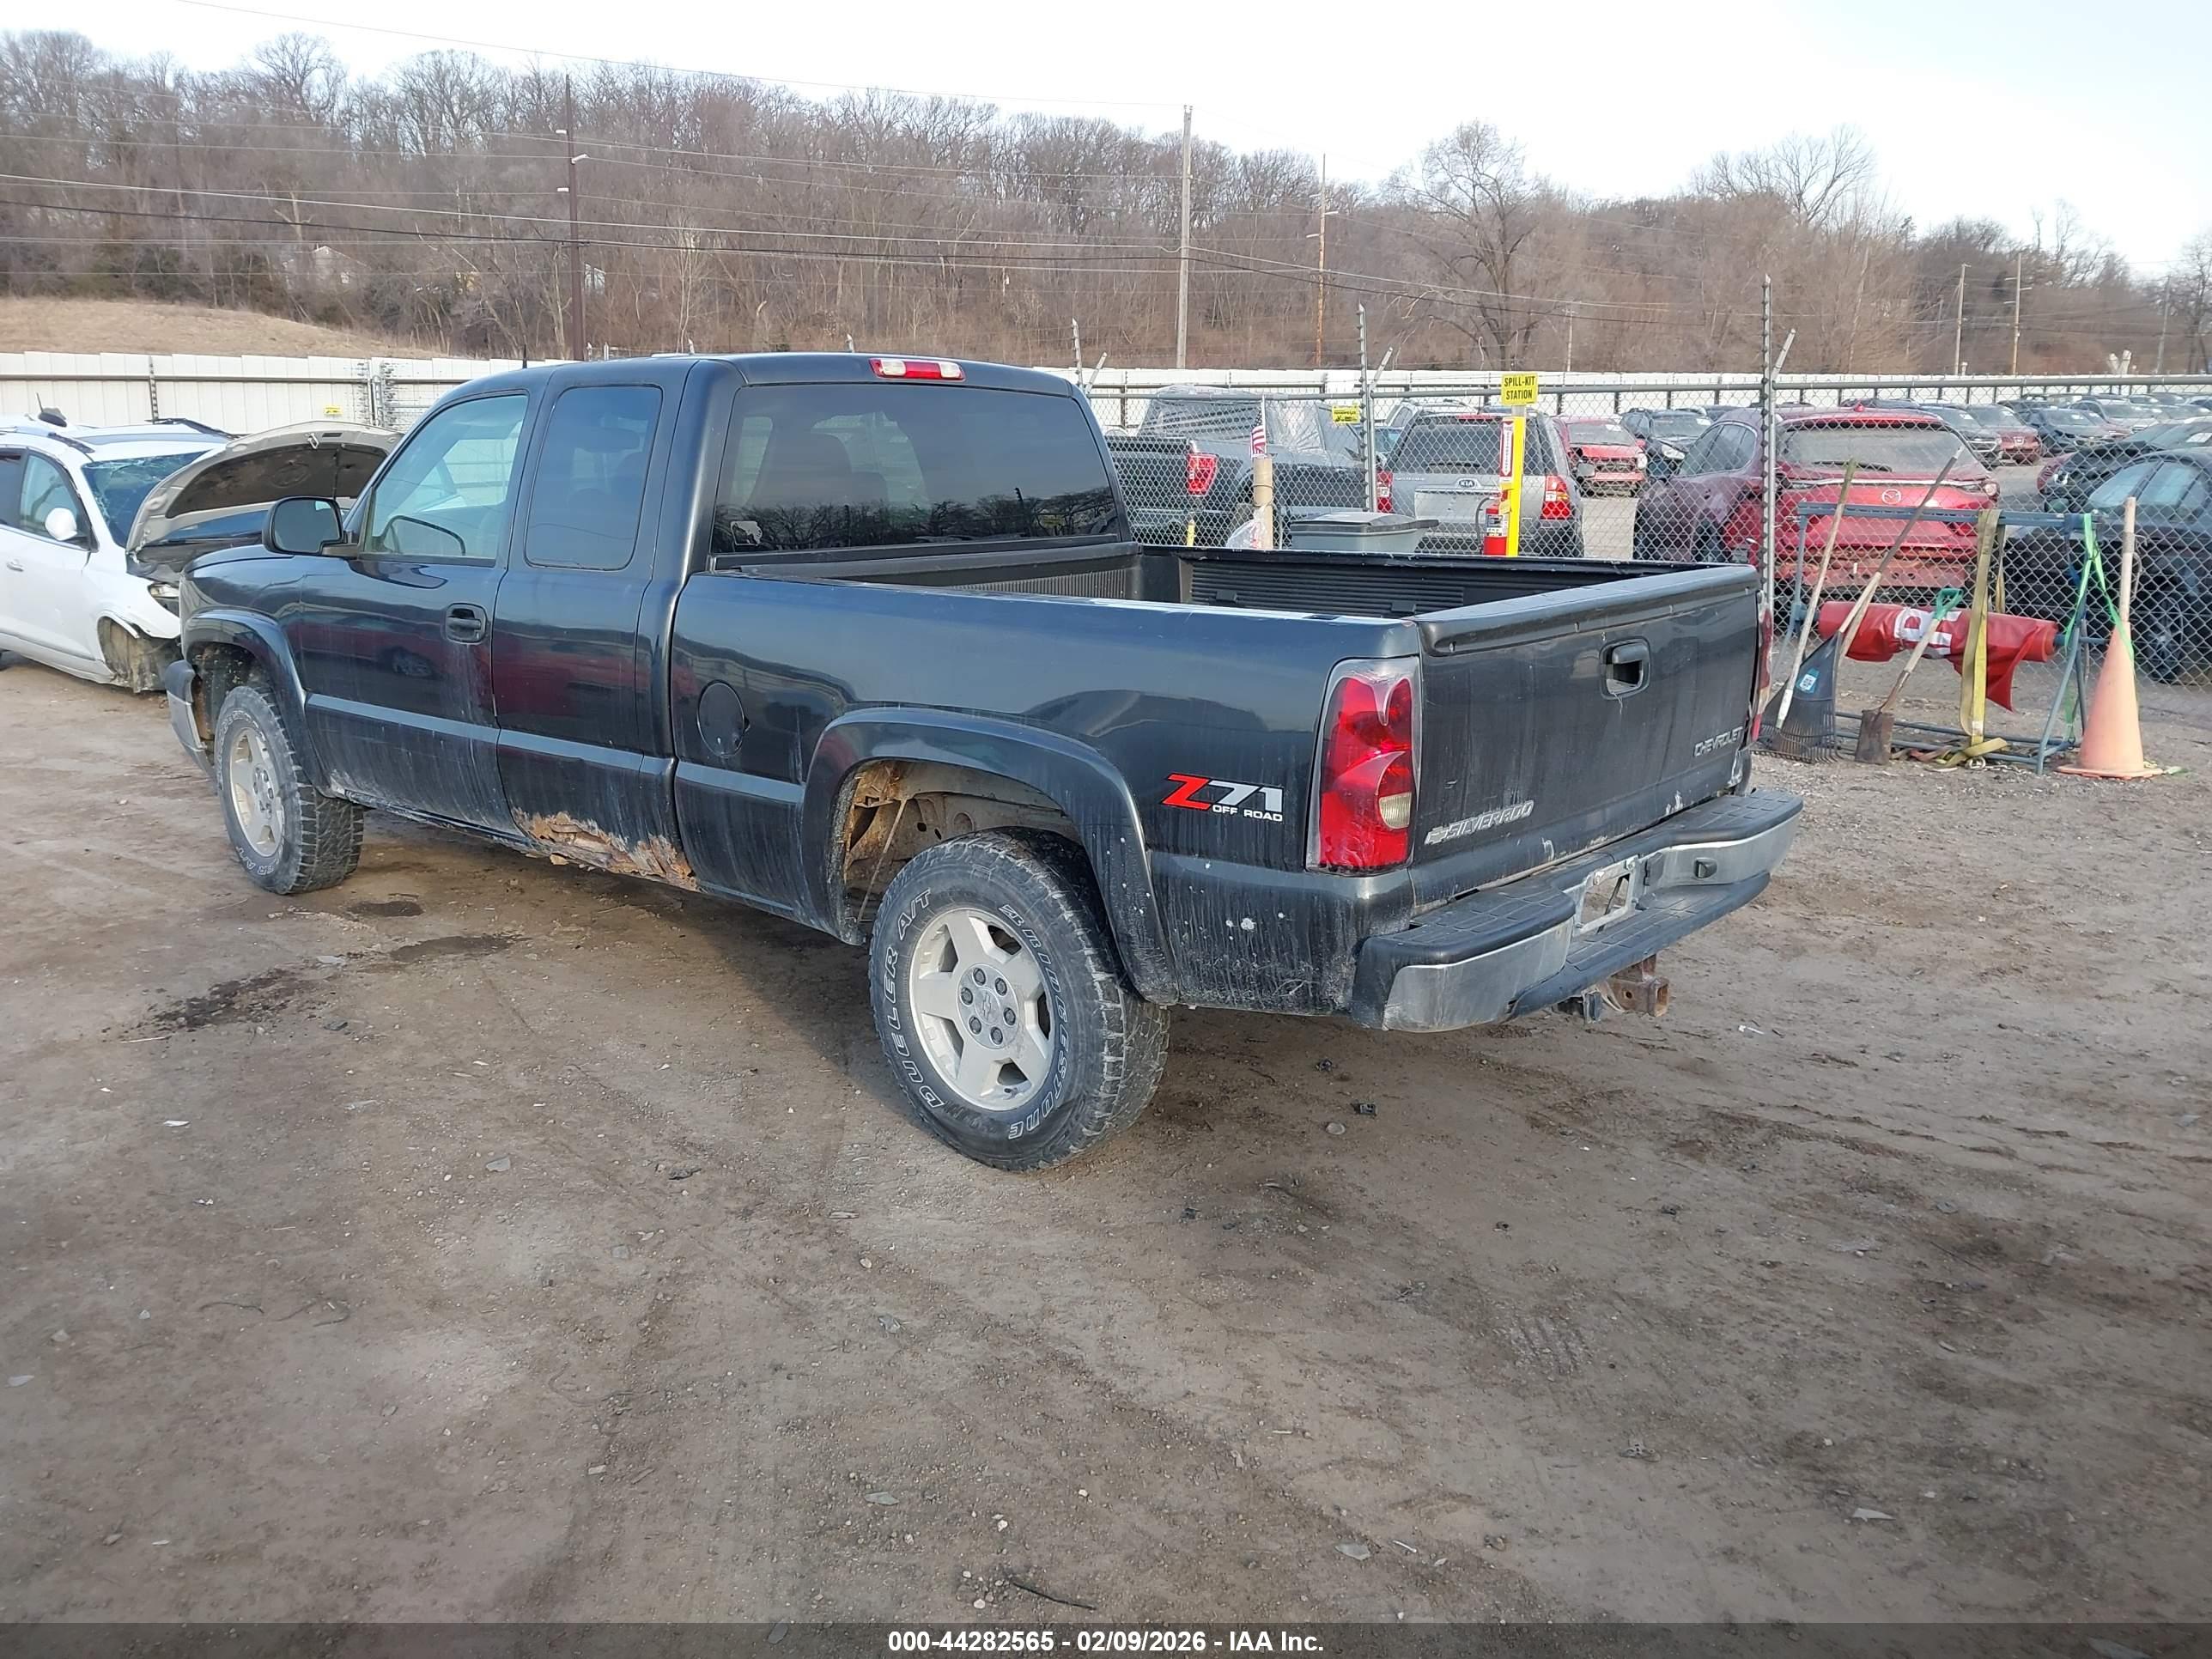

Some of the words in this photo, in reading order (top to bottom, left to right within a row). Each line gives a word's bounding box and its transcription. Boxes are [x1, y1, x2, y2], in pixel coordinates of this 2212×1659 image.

[1504, 375, 1535, 386] SPILL-KIT
[1506, 389, 1533, 400] STATION
[1694, 726, 1743, 757] CHEVROLET
[1162, 773, 1283, 812] Z71
[1212, 804, 1238, 816] OFF
[1243, 809, 1283, 822] ROAD
[1447, 799, 1534, 839] SILVERADO
[897, 889, 932, 940] A/T
[884, 946, 945, 1109] DUELER
